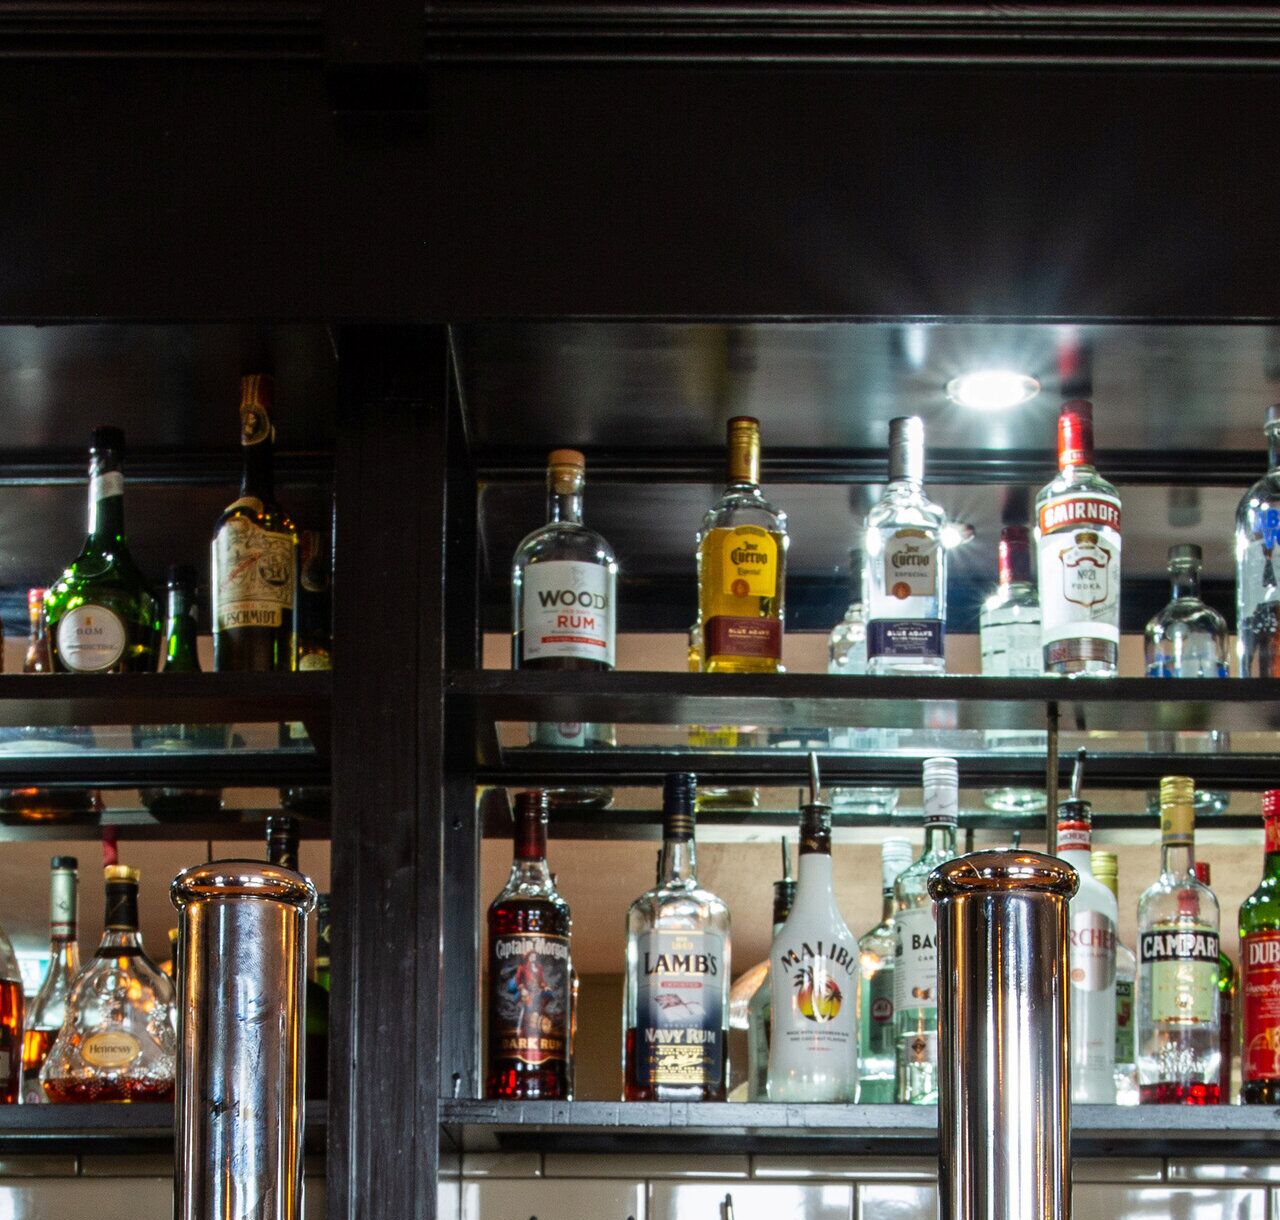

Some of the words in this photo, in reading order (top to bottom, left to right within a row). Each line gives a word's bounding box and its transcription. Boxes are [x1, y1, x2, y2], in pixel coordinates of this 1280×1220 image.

[1044, 502, 1119, 528] SMIRNOFF
[730, 547, 768, 565] Cuervo
[891, 550, 930, 567] Cuervo
[557, 615, 595, 629] RUM
[496, 939, 532, 959] Captain
[532, 938, 568, 960] Morgan
[1143, 935, 1218, 958] CAMPARI
[644, 952, 718, 977] LAMB'S
[780, 941, 856, 977] MALIBU
[502, 1036, 538, 1049] DARK
[645, 1028, 685, 1045] NAVY
[686, 1028, 717, 1045] RUM
[89, 1042, 133, 1056] Hennessy
